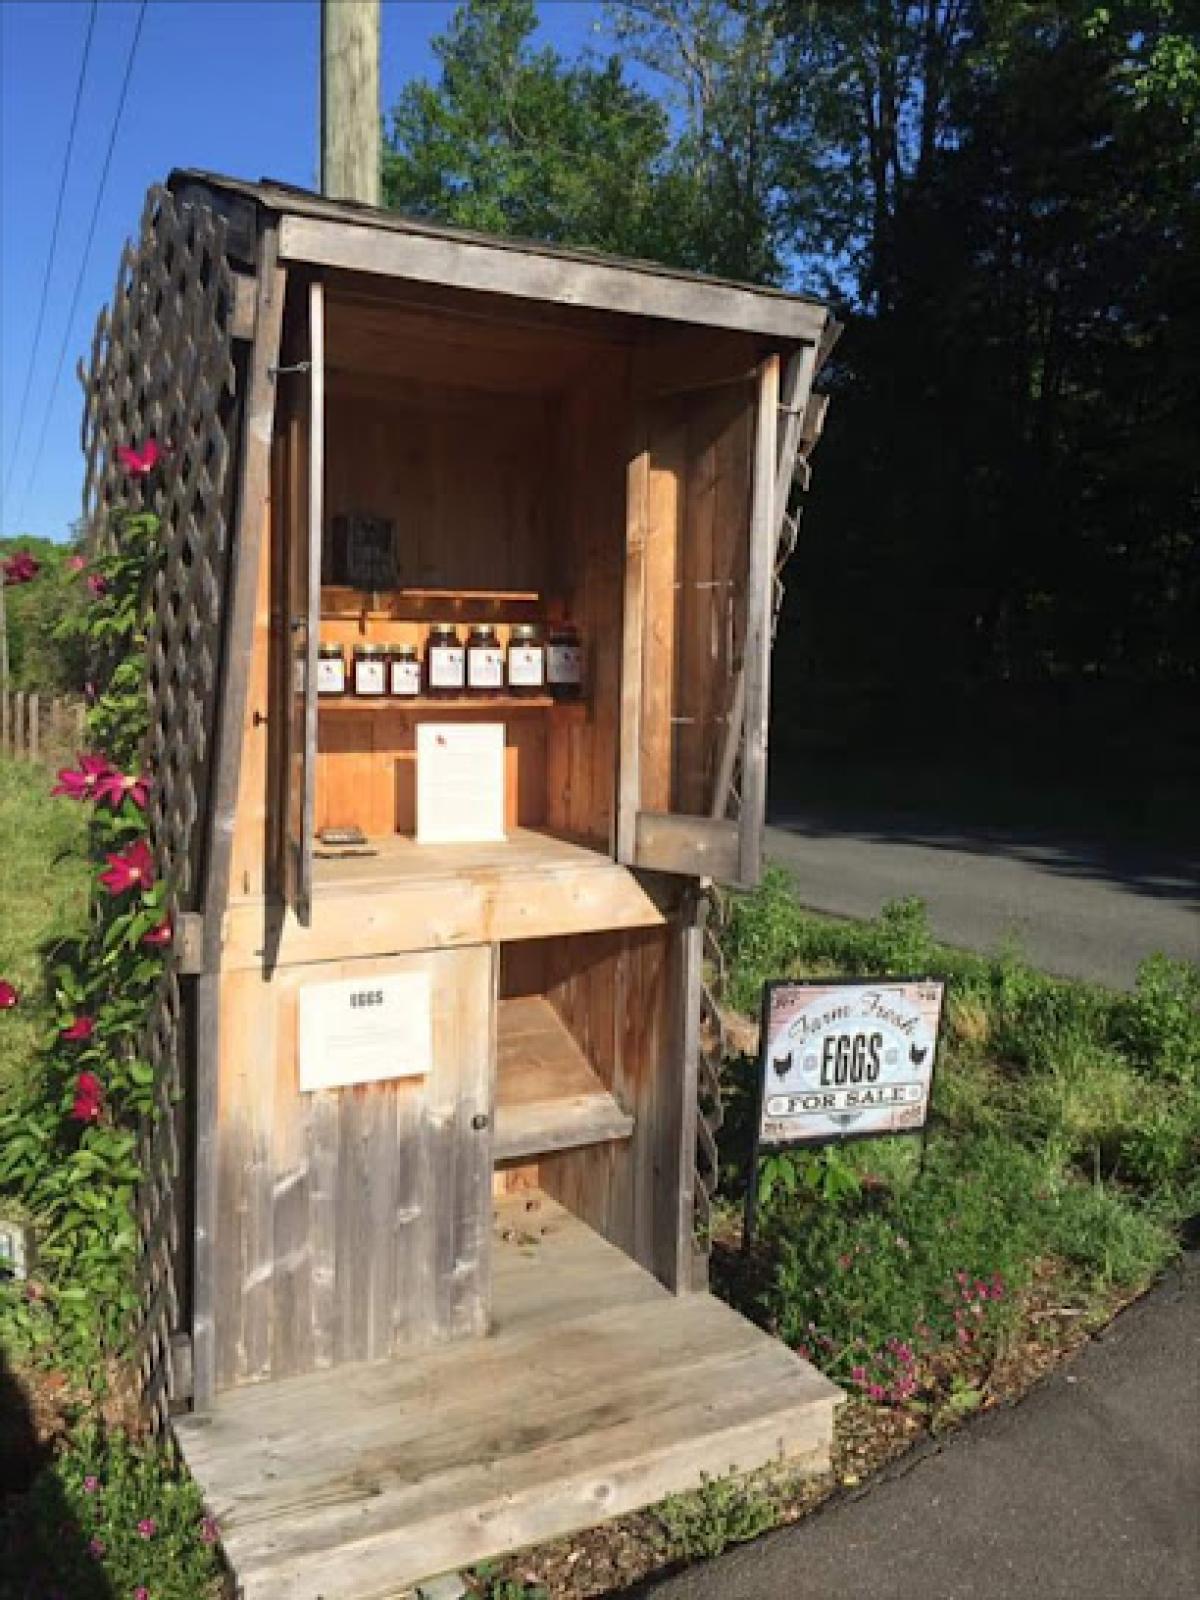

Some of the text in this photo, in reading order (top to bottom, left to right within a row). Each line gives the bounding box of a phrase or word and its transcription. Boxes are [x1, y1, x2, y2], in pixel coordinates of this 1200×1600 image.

[820, 1032, 883, 1086] EGGS
[788, 1086, 905, 1112] FOR SALE
